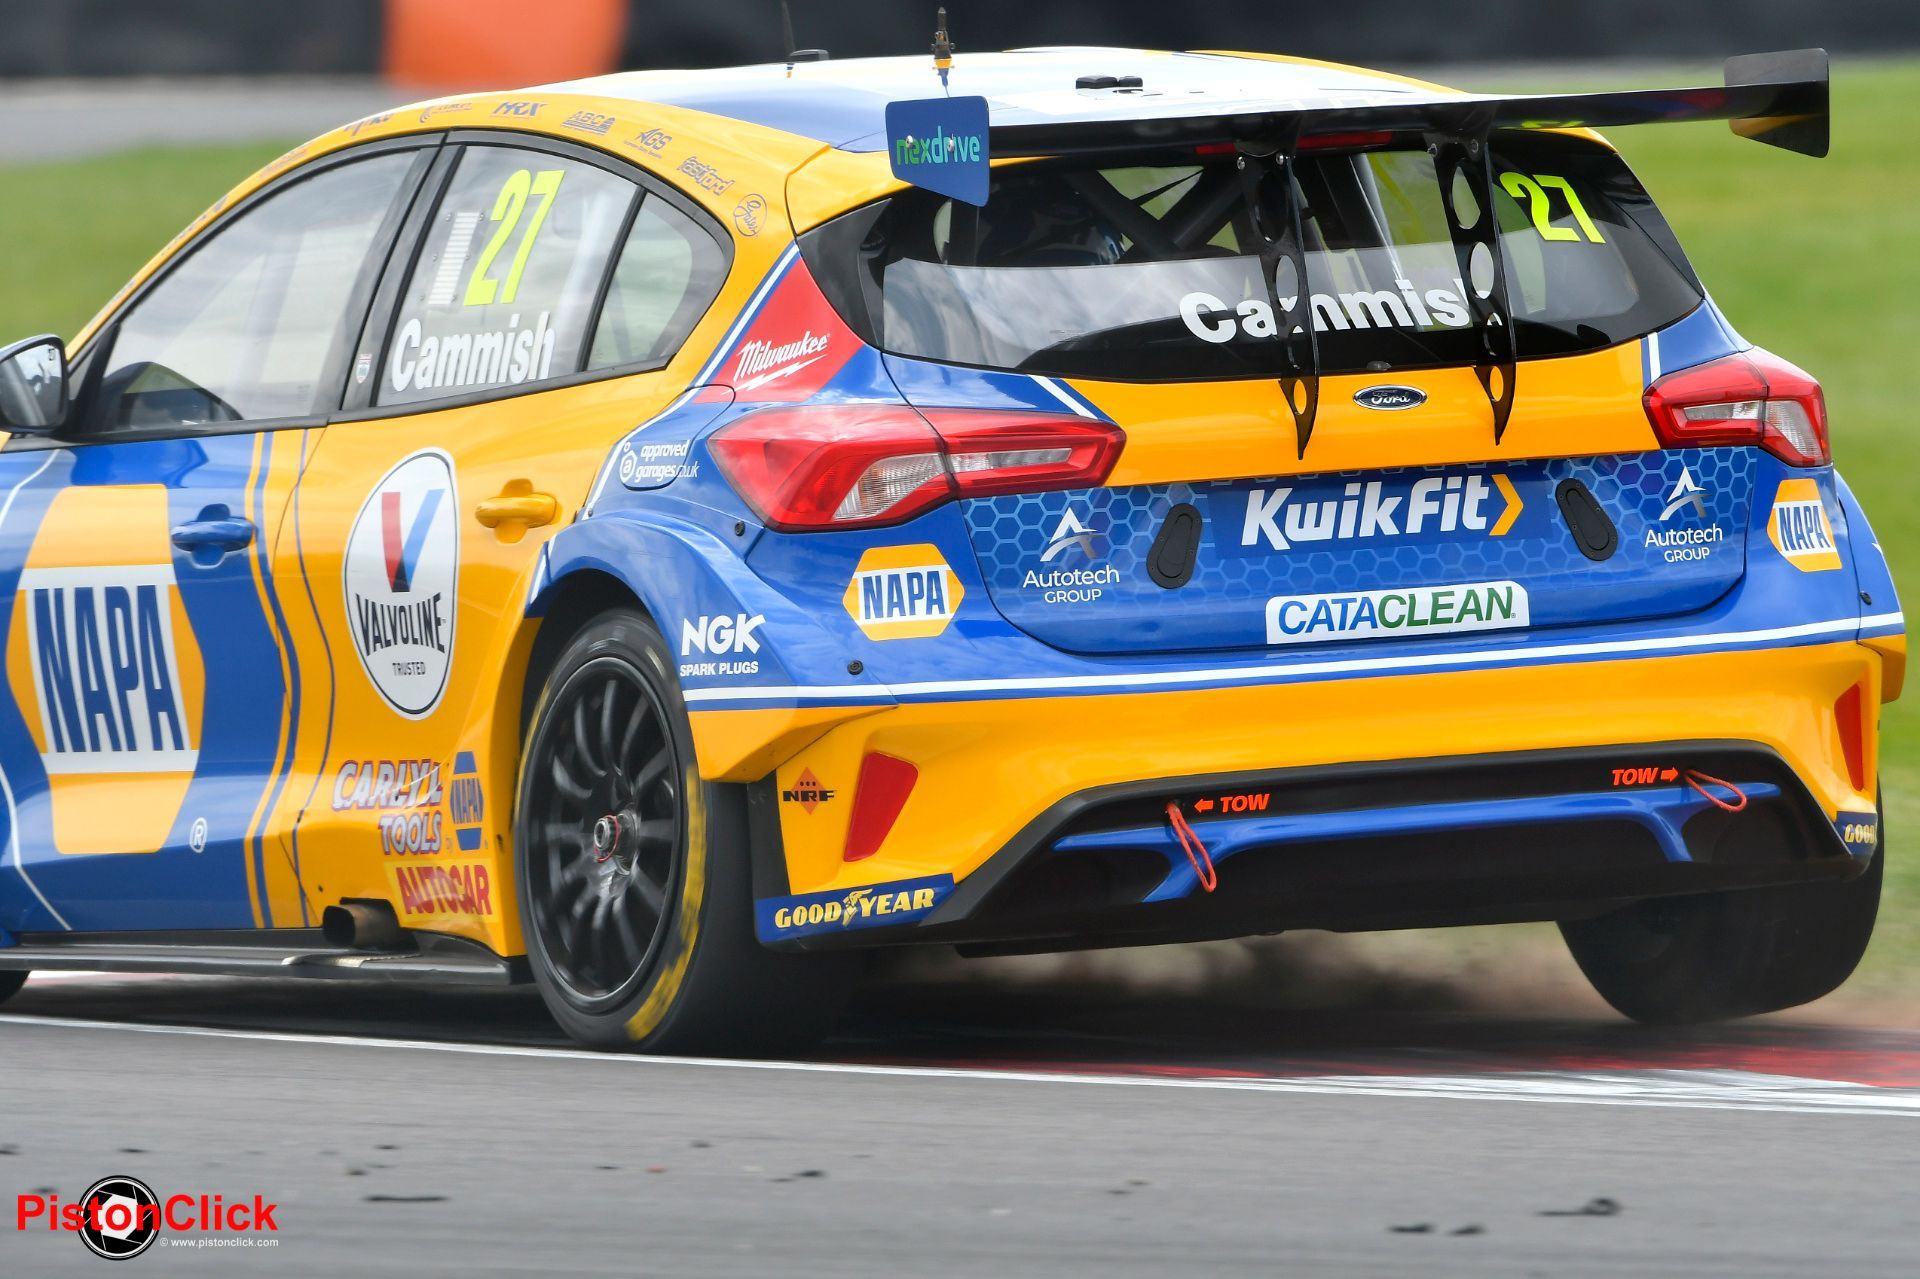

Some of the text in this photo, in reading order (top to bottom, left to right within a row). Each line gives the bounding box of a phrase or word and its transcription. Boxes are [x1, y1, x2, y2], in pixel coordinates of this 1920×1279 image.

[896, 125, 980, 166] nexdrive
[1499, 172, 1606, 244] 27
[463, 169, 566, 306] 27
[392, 311, 556, 392] Cammish
[733, 331, 828, 382] Milwaukee
[1371, 389, 1411, 405] Ford
[640, 439, 691, 462] approved
[1644, 523, 1723, 548] Autotech
[1778, 504, 1832, 552] NAPA
[1664, 547, 1710, 563] GROUP
[862, 570, 946, 620] NAPA
[1023, 565, 1120, 588] Autotech
[1044, 588, 1103, 604] GROUP
[355, 592, 446, 657] VALVOLINE
[1278, 586, 1513, 635] CATACLEAN
[681, 614, 766, 656] NGK
[34, 584, 185, 753] NAPA
[680, 661, 759, 677] SPARK PLUGS
[782, 790, 835, 802] NRF
[1612, 767, 1660, 786] TOW
[1220, 793, 1270, 813] TOW
[378, 810, 442, 855] TOOLS
[396, 864, 493, 915] AUTOCAR
